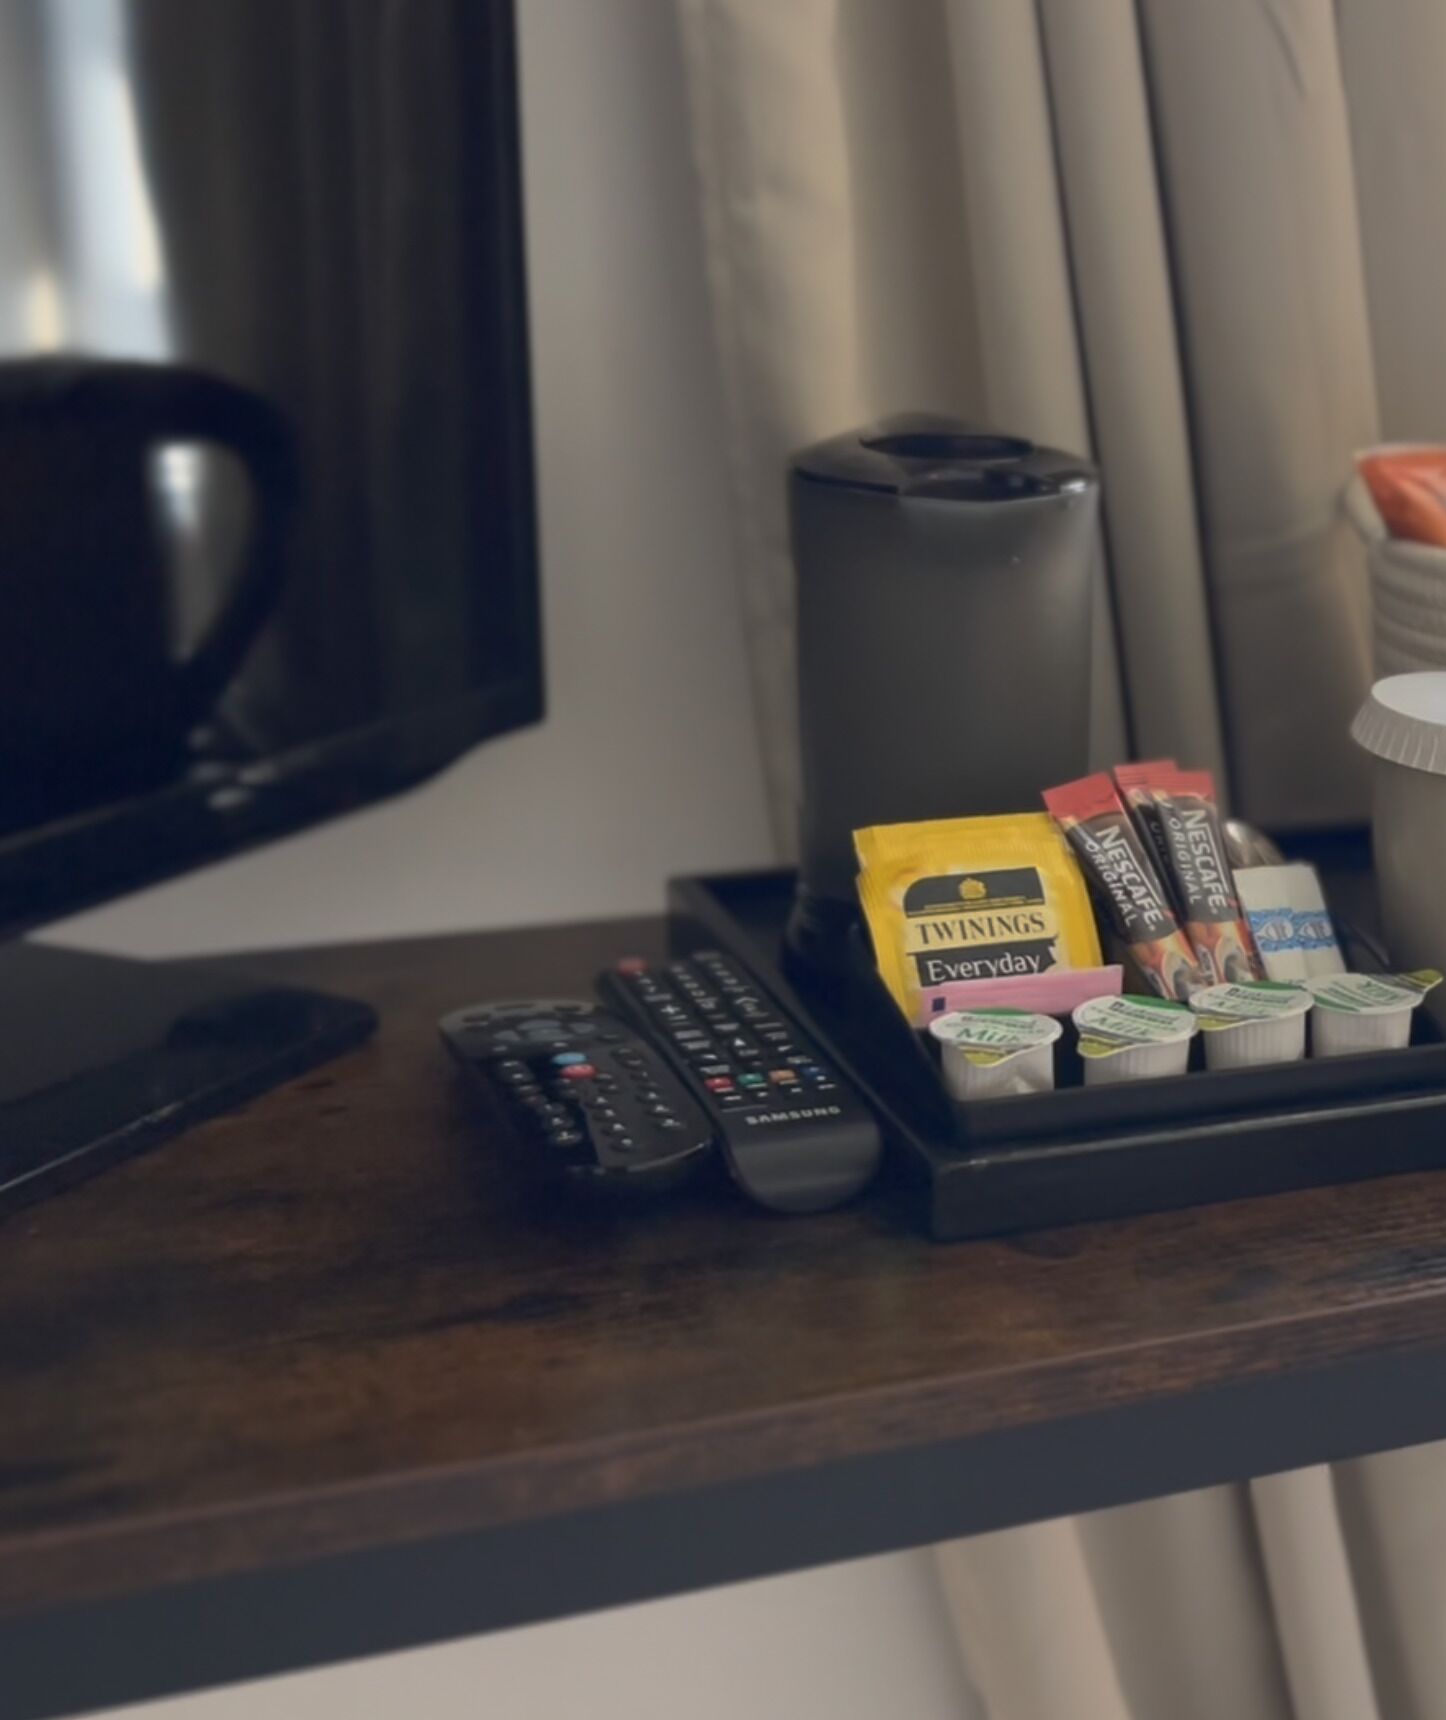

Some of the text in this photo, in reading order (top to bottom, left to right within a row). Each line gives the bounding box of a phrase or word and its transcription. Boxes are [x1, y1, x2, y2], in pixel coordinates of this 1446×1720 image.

[1168, 817, 1203, 905] ORIGINAL
[1085, 840, 1138, 928] ORIGINAL
[916, 912, 1045, 945] TWININGS
[927, 952, 1040, 982] Everyday
[745, 1105, 841, 1125] SAMSUNG
